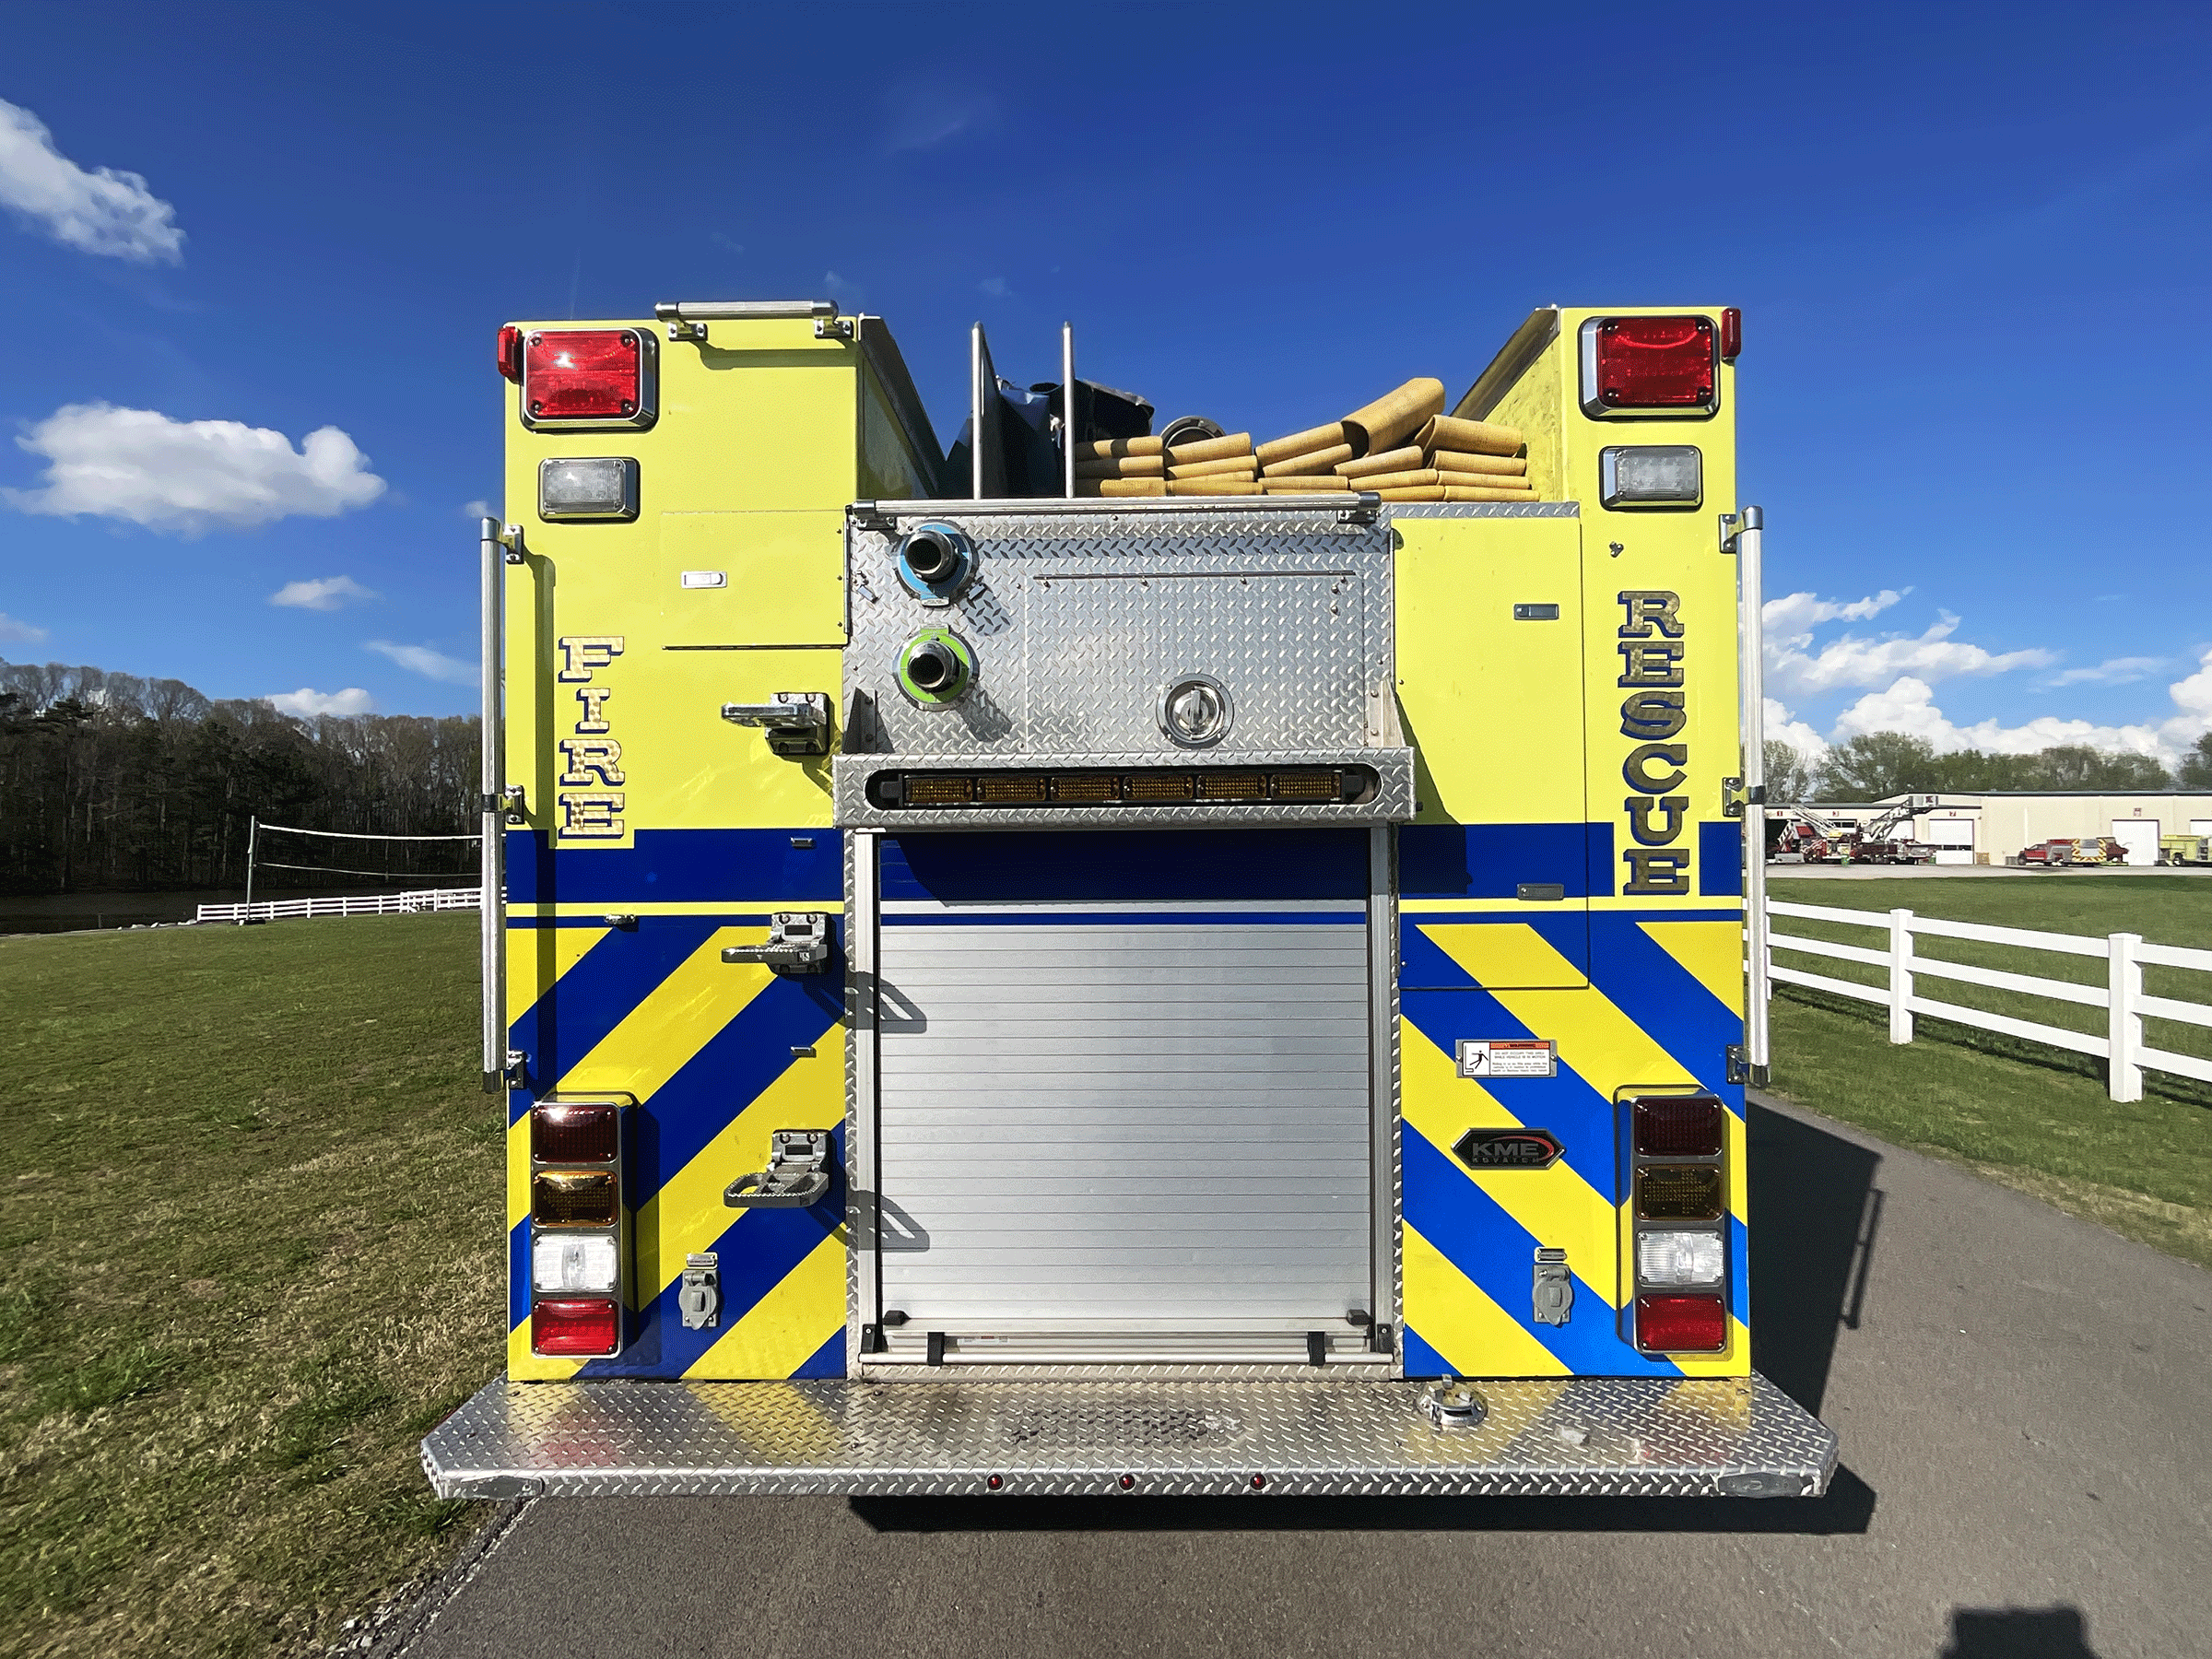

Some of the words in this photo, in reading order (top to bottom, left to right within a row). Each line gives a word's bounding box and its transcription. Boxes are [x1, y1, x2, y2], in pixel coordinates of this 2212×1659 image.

[558, 636, 625, 839] FIRE
[1618, 591, 1689, 896] RESCUE
[1472, 1142, 1539, 1156] KME
